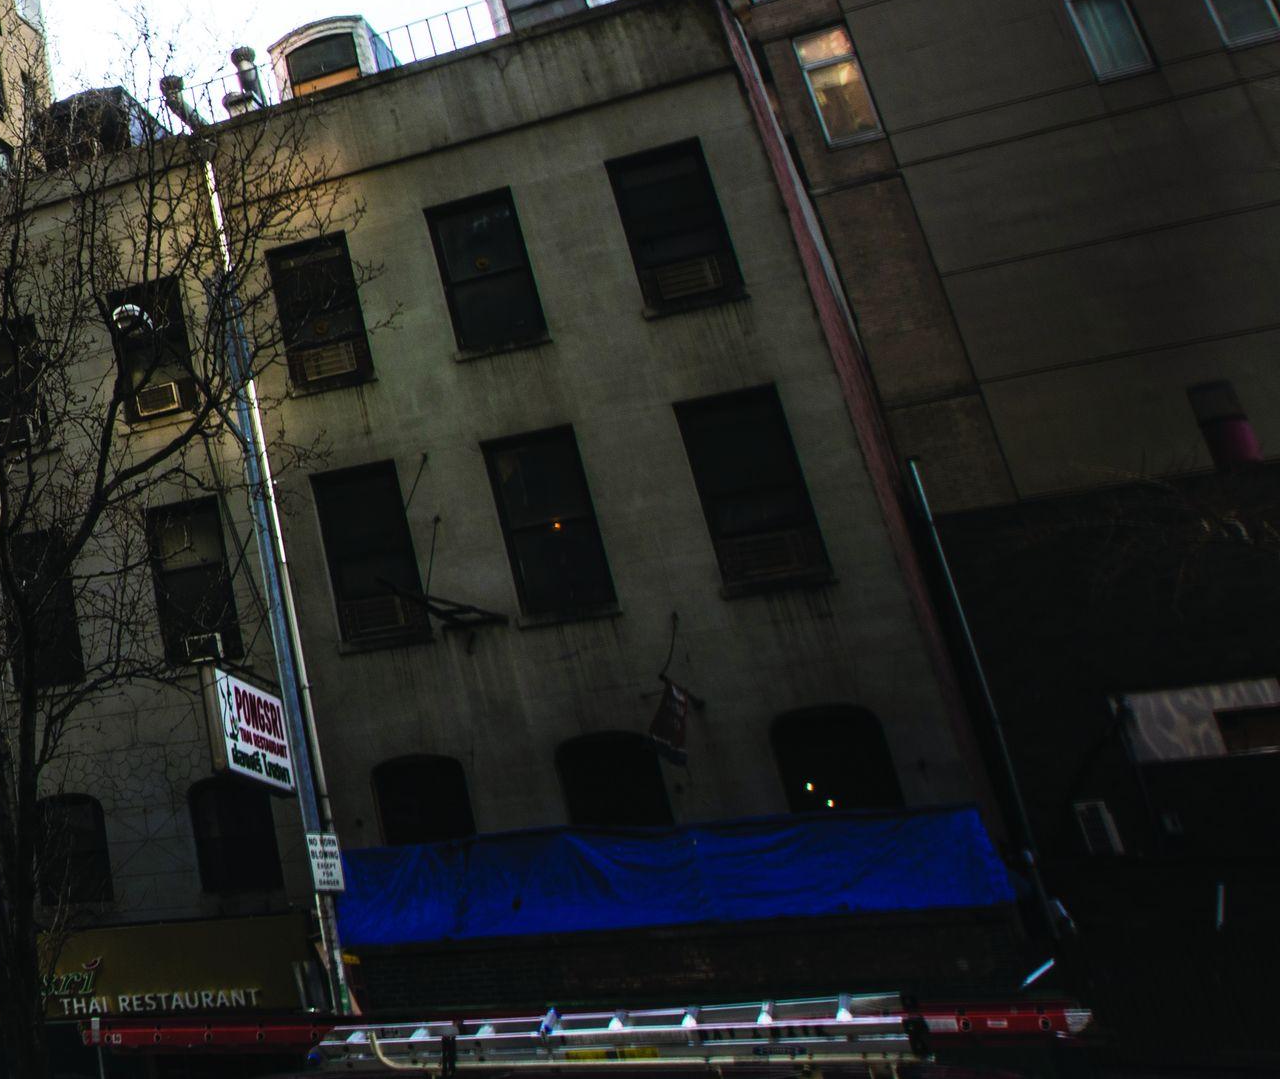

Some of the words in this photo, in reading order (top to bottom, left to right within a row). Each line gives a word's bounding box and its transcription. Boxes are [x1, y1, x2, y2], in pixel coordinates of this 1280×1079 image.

[234, 685, 285, 742] PONGSRI
[308, 838, 318, 848] NO
[60, 995, 108, 1016] THAI
[118, 987, 262, 1013] RESTAURANT
